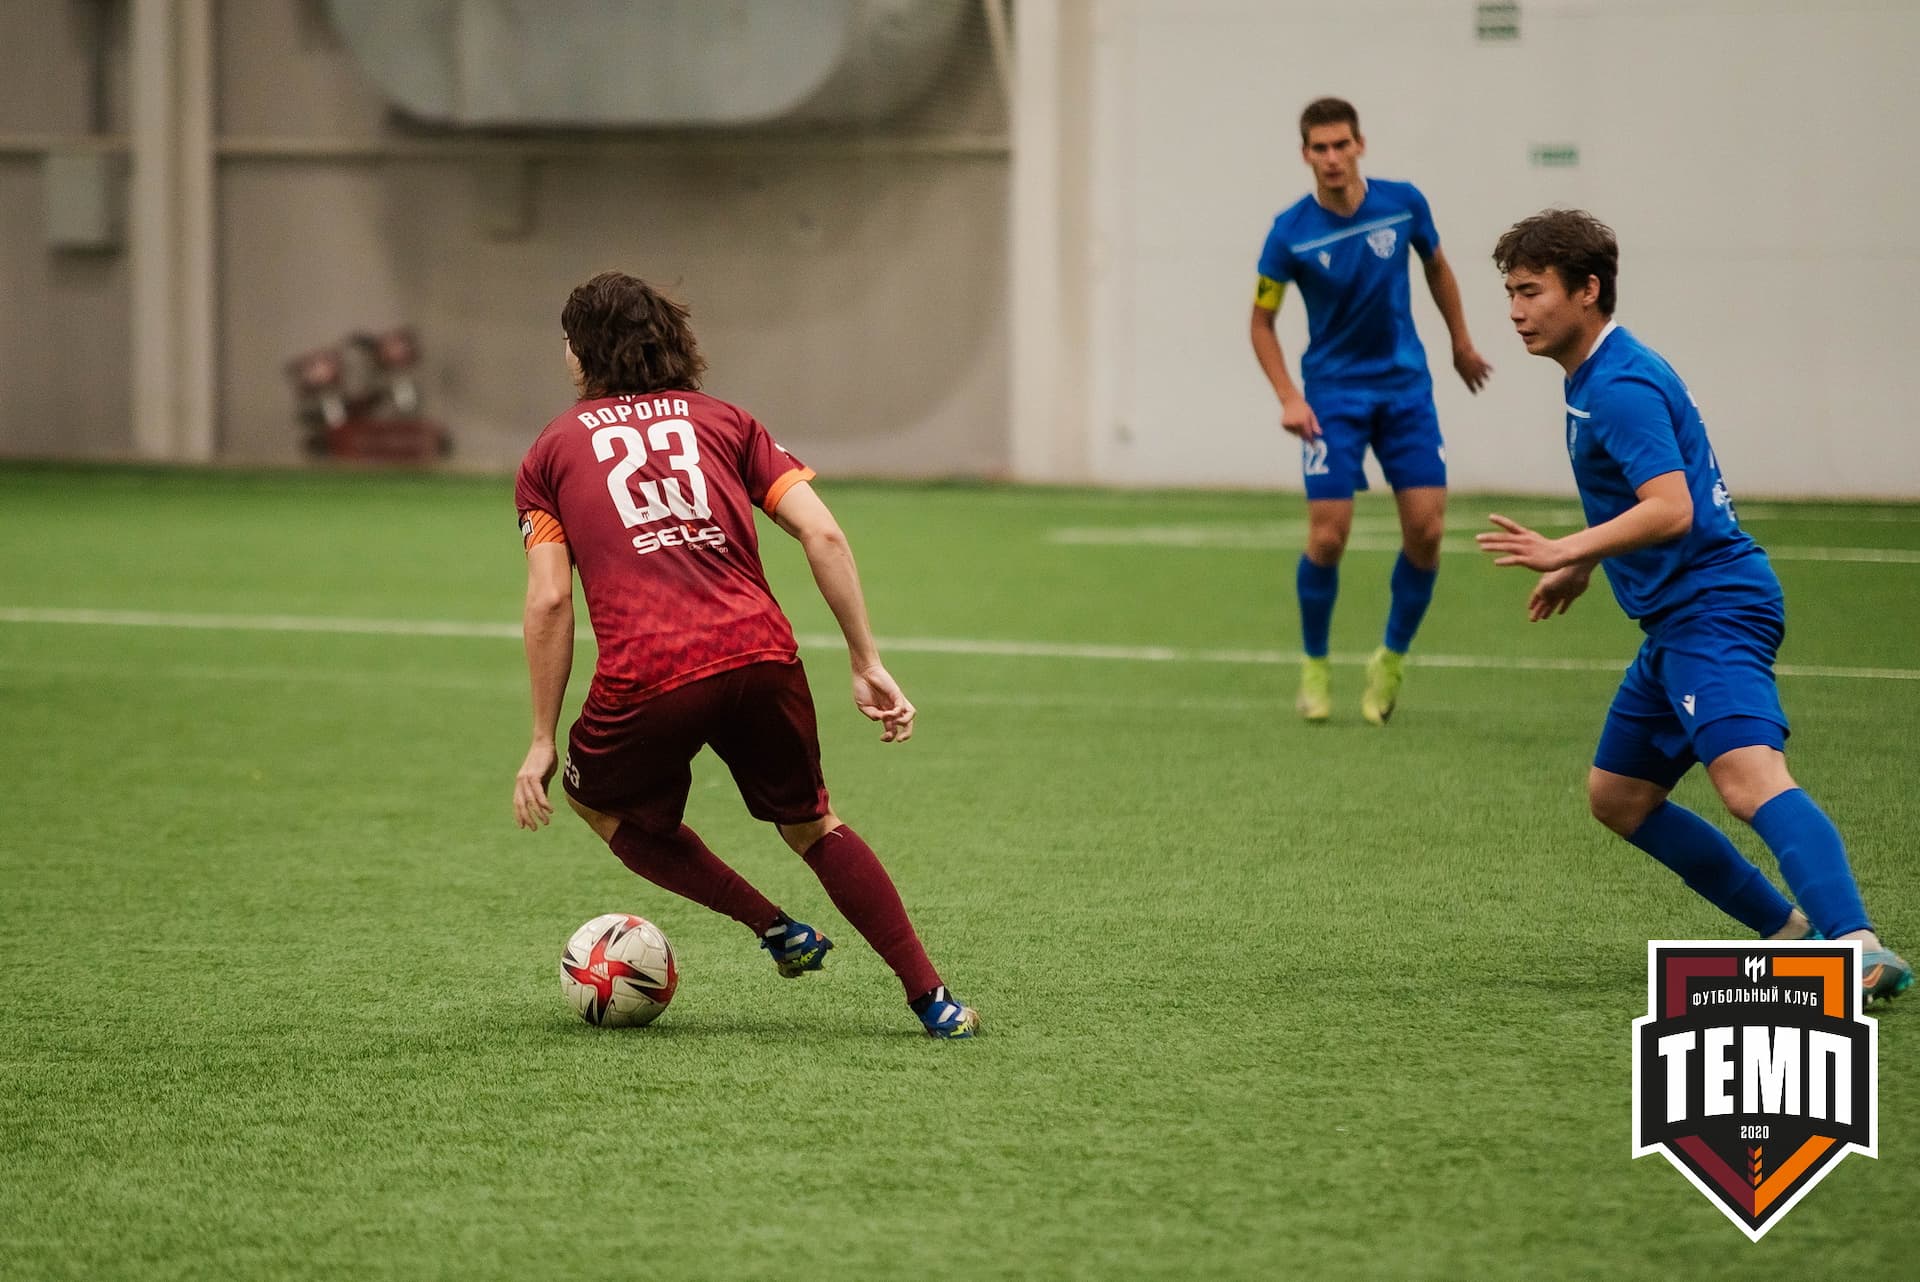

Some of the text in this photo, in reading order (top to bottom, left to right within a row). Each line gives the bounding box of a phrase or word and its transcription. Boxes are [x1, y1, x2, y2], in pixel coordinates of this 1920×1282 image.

[577, 398, 689, 430] ВОРОНА
[591, 419, 712, 529] 23
[632, 524, 726, 554] SELS
[565, 752, 580, 789] 23
